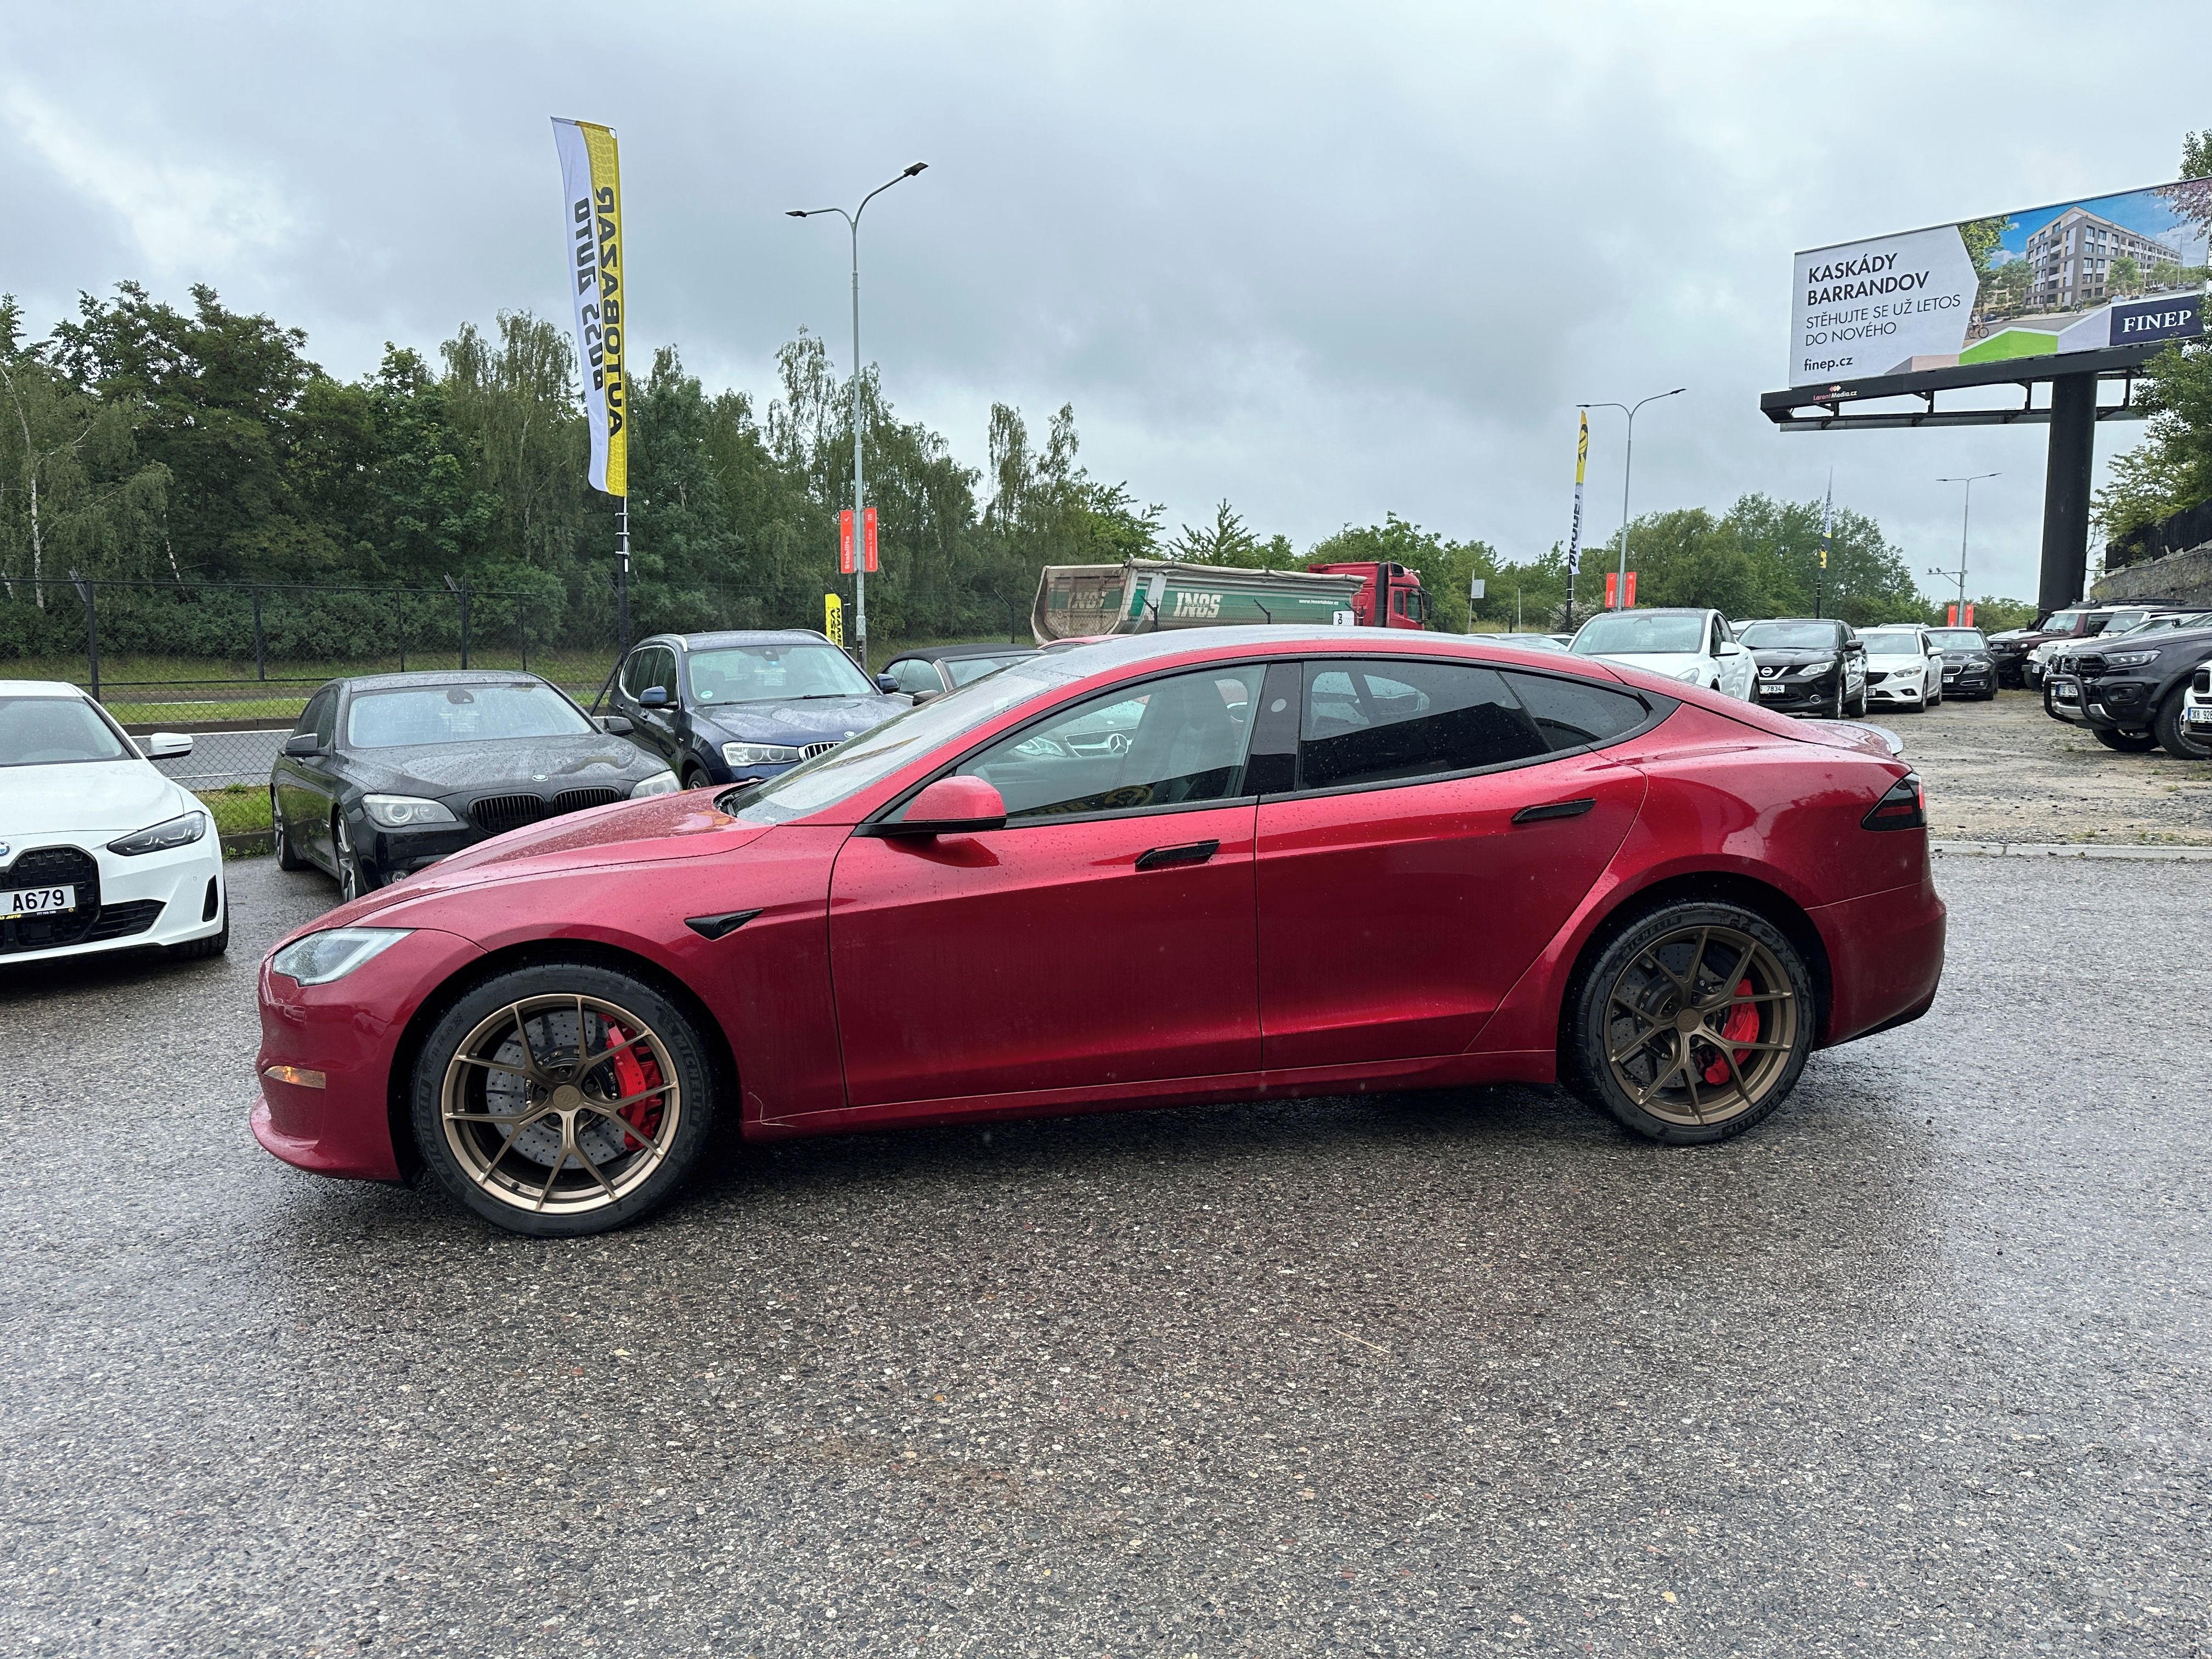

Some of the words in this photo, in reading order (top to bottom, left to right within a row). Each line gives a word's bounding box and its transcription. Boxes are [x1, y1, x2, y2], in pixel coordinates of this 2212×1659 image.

[1808, 253, 1898, 284] KASKÁDY
[1808, 271, 1929, 306] BARRANDOV
[1806, 308, 1869, 329] STĚHUJTE
[1873, 305, 1889, 318] SE
[1893, 298, 1912, 315] UŽ
[1917, 294, 1961, 313] LETOS
[2122, 310, 2192, 333] FINEP
[1805, 332, 1827, 346] DO
[1831, 321, 1897, 342] NOVÉHO
[1804, 357, 1853, 371] finep.cz
[1813, 391, 1858, 400] LarentMedia.cz
[1173, 592, 1221, 618] INOS
[13, 889, 65, 912] A679
[1622, 916, 1679, 958] MICHELIN
[672, 1033, 702, 1122] MICHELIN
[1725, 1092, 1780, 1135] MICHELIN
[419, 1086, 452, 1176] MICHELIN
